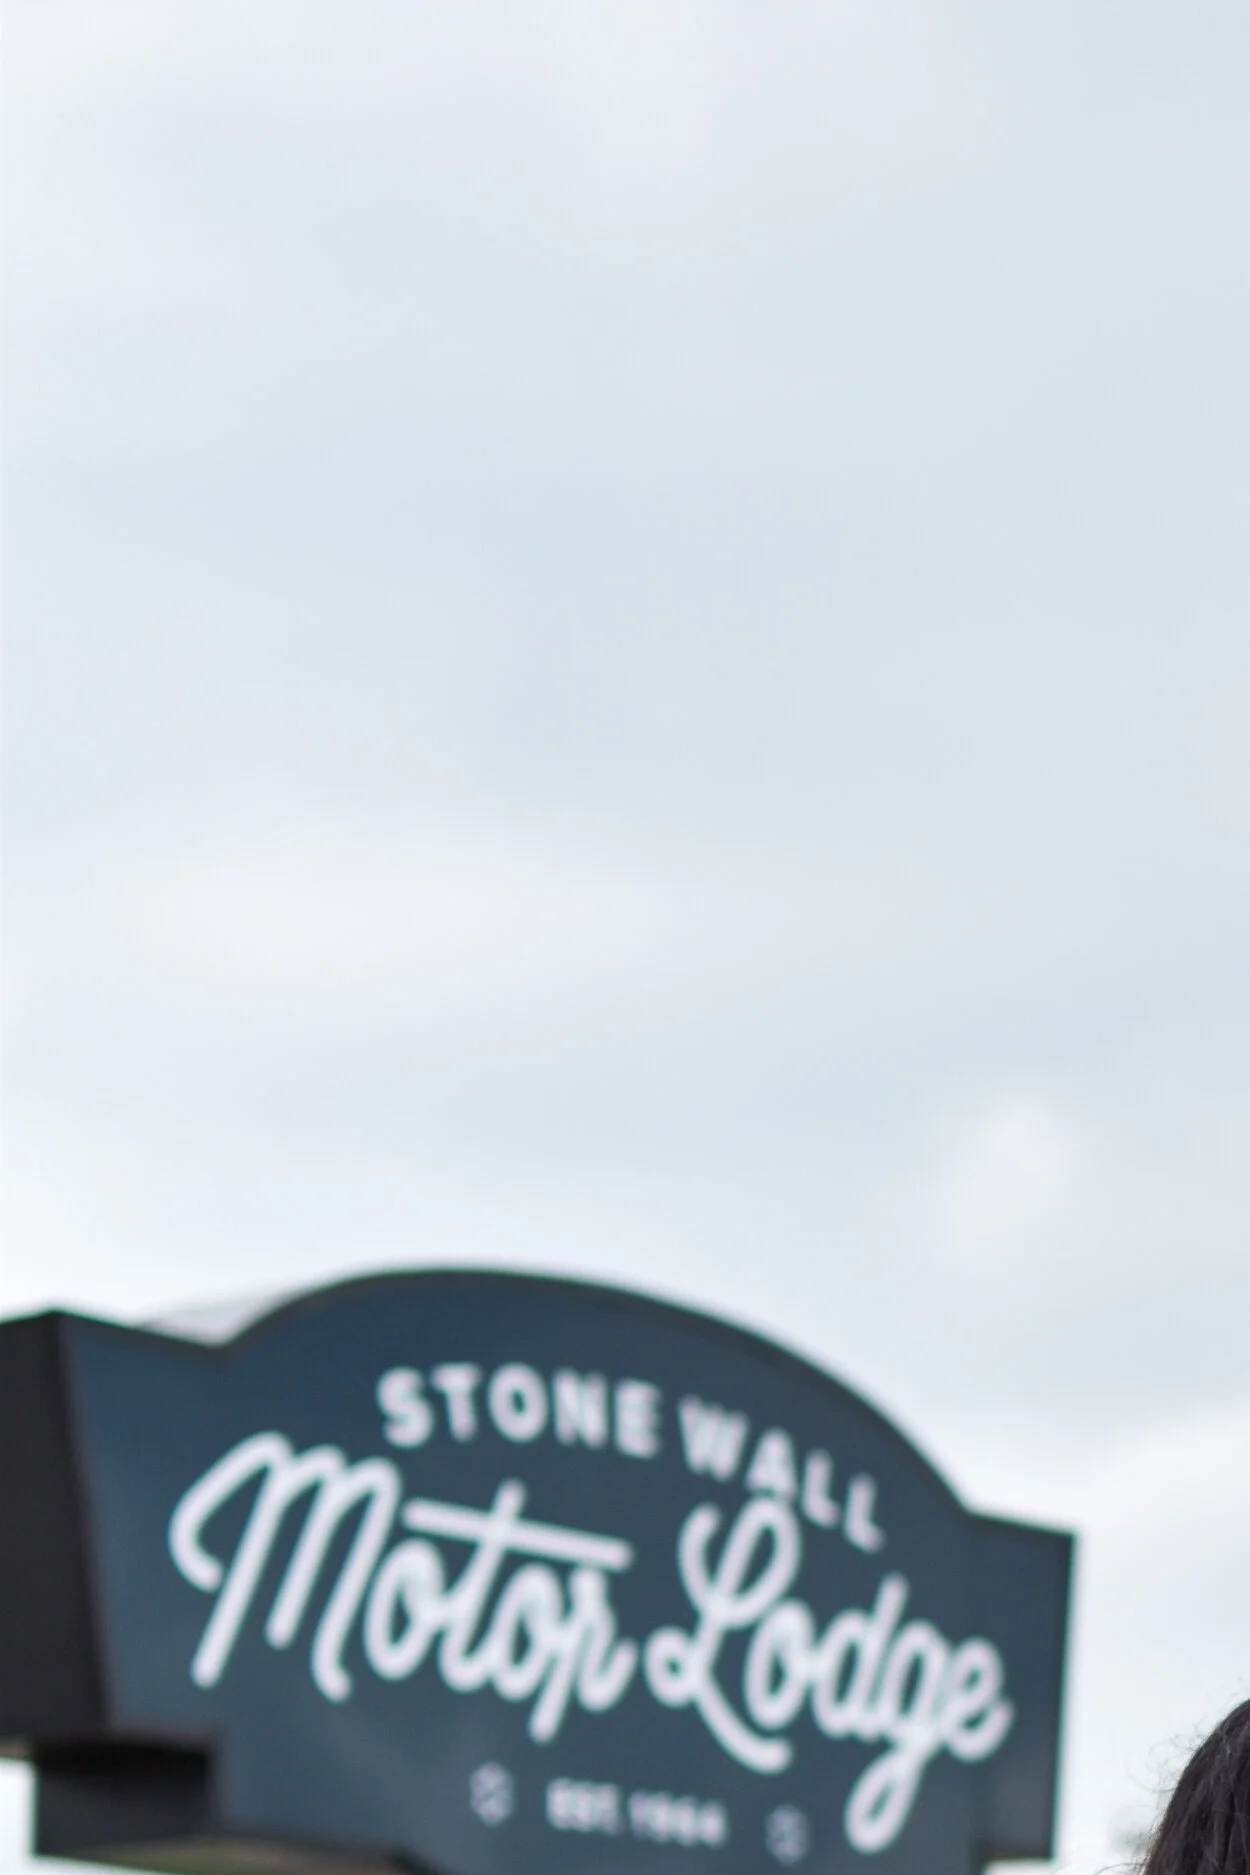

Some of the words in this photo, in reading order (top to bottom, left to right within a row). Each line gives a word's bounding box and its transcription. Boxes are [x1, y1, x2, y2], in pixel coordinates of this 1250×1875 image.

[376, 1364, 660, 1458] STONE
[678, 1400, 882, 1552] WALL
[168, 1431, 638, 1743] Motor
[643, 1498, 1012, 1854] Lodge
